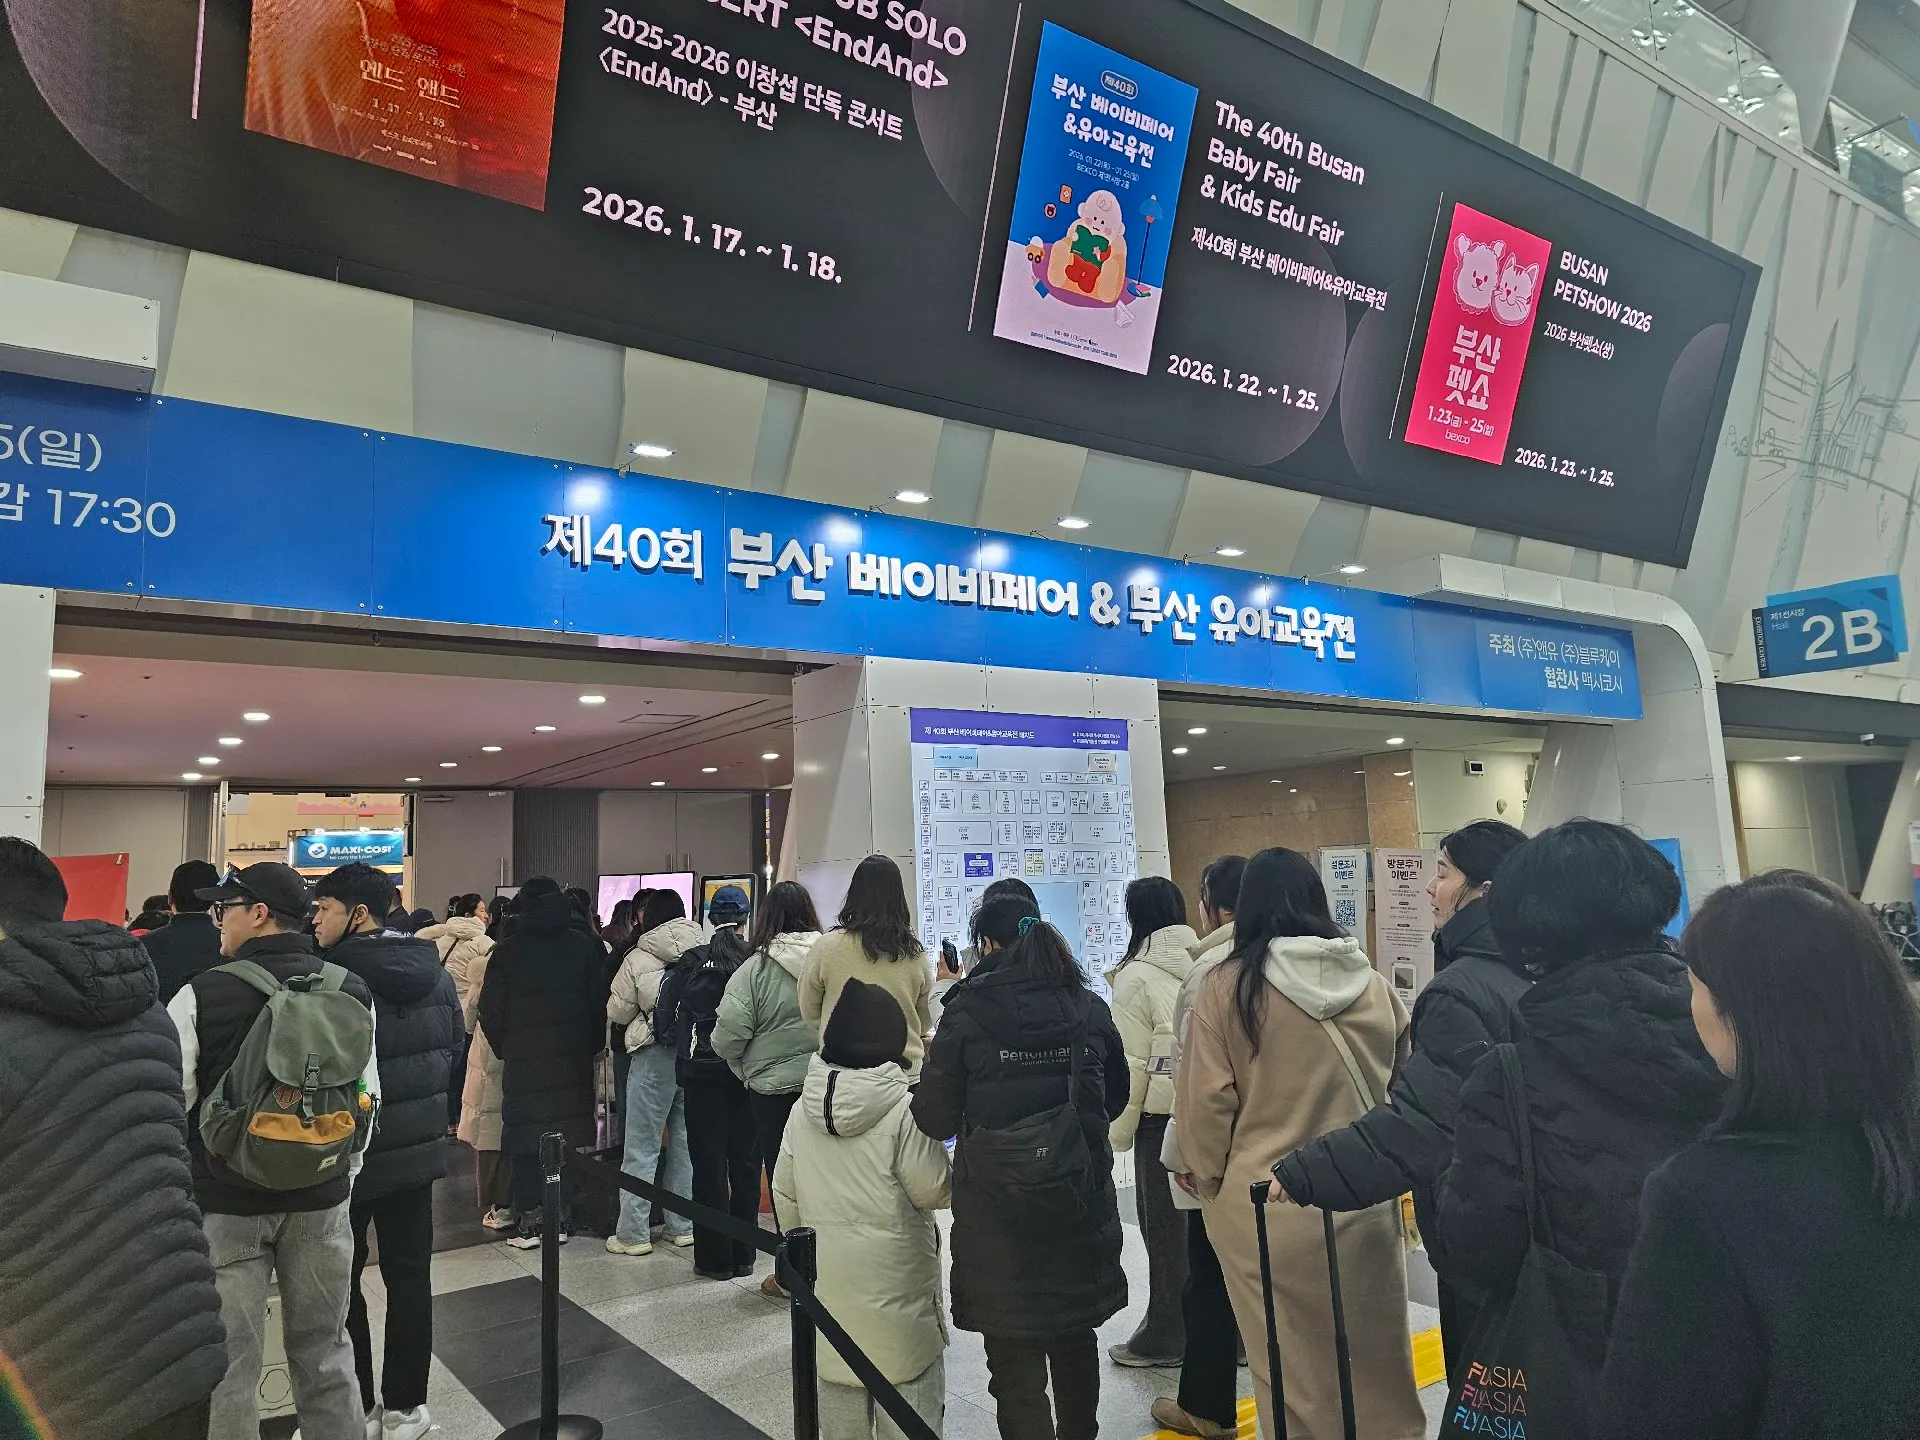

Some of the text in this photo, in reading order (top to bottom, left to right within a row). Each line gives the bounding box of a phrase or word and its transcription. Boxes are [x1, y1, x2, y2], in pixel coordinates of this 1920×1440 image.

[794, 15, 949, 89] <EndAnd>
[885, 2, 967, 56] SOLO
[360, 59, 461, 109] 엔드 앤드
[602, 8, 904, 141] 2025-2026 이창섭 단독 콘서트
[1104, 74, 1135, 95] 제40회
[734, 93, 778, 131] 부산
[1051, 73, 1175, 142] 부산 베이비페어
[1063, 113, 1155, 169] &유아교육전
[1207, 138, 1302, 194] Baby Fair
[1214, 100, 1365, 186] The 40th Busan
[582, 187, 842, 284] 2026. 1. 17. ~ 1. 18.
[1200, 174, 1345, 247] & Kids Edu Fair
[1191, 226, 1388, 311] 제40회 부산 베이비페어&유아교육전
[1559, 250, 1609, 287] BUSAN
[1553, 278, 1653, 333] PETSHOW 2026
[1452, 325, 1502, 374] 부산
[1543, 321, 1568, 342] 2026
[1168, 355, 1319, 411] 2026. 1. 22. ~ 1. 25.
[1445, 364, 1490, 410] 펫쇼
[1427, 405, 1462, 428] 1.23(금)
[1469, 418, 1495, 437] 25(일)
[1514, 447, 1547, 471] 2026.
[1550, 456, 1558, 473] 1.
[1560, 458, 1577, 478] 23.
[1589, 467, 1597, 484] 1.
[1598, 470, 1615, 487] 25.
[46, 488, 176, 538] 17:30
[541, 514, 1357, 660] 제40회 부산 베이비페어 & 부산 유아교육전
[1769, 607, 1805, 621] 제1전시장
[1771, 621, 1790, 631] Hall
[1802, 608, 1883, 661] 2B
[1488, 633, 1621, 669] 주최 (주)앤유 (주)블루케이
[1543, 666, 1624, 695] 협찬사 맥시코시
[1334, 870, 1355, 880] 이벤트
[1386, 858, 1423, 870] 방문후기
[1391, 869, 1418, 881] 이벤트
